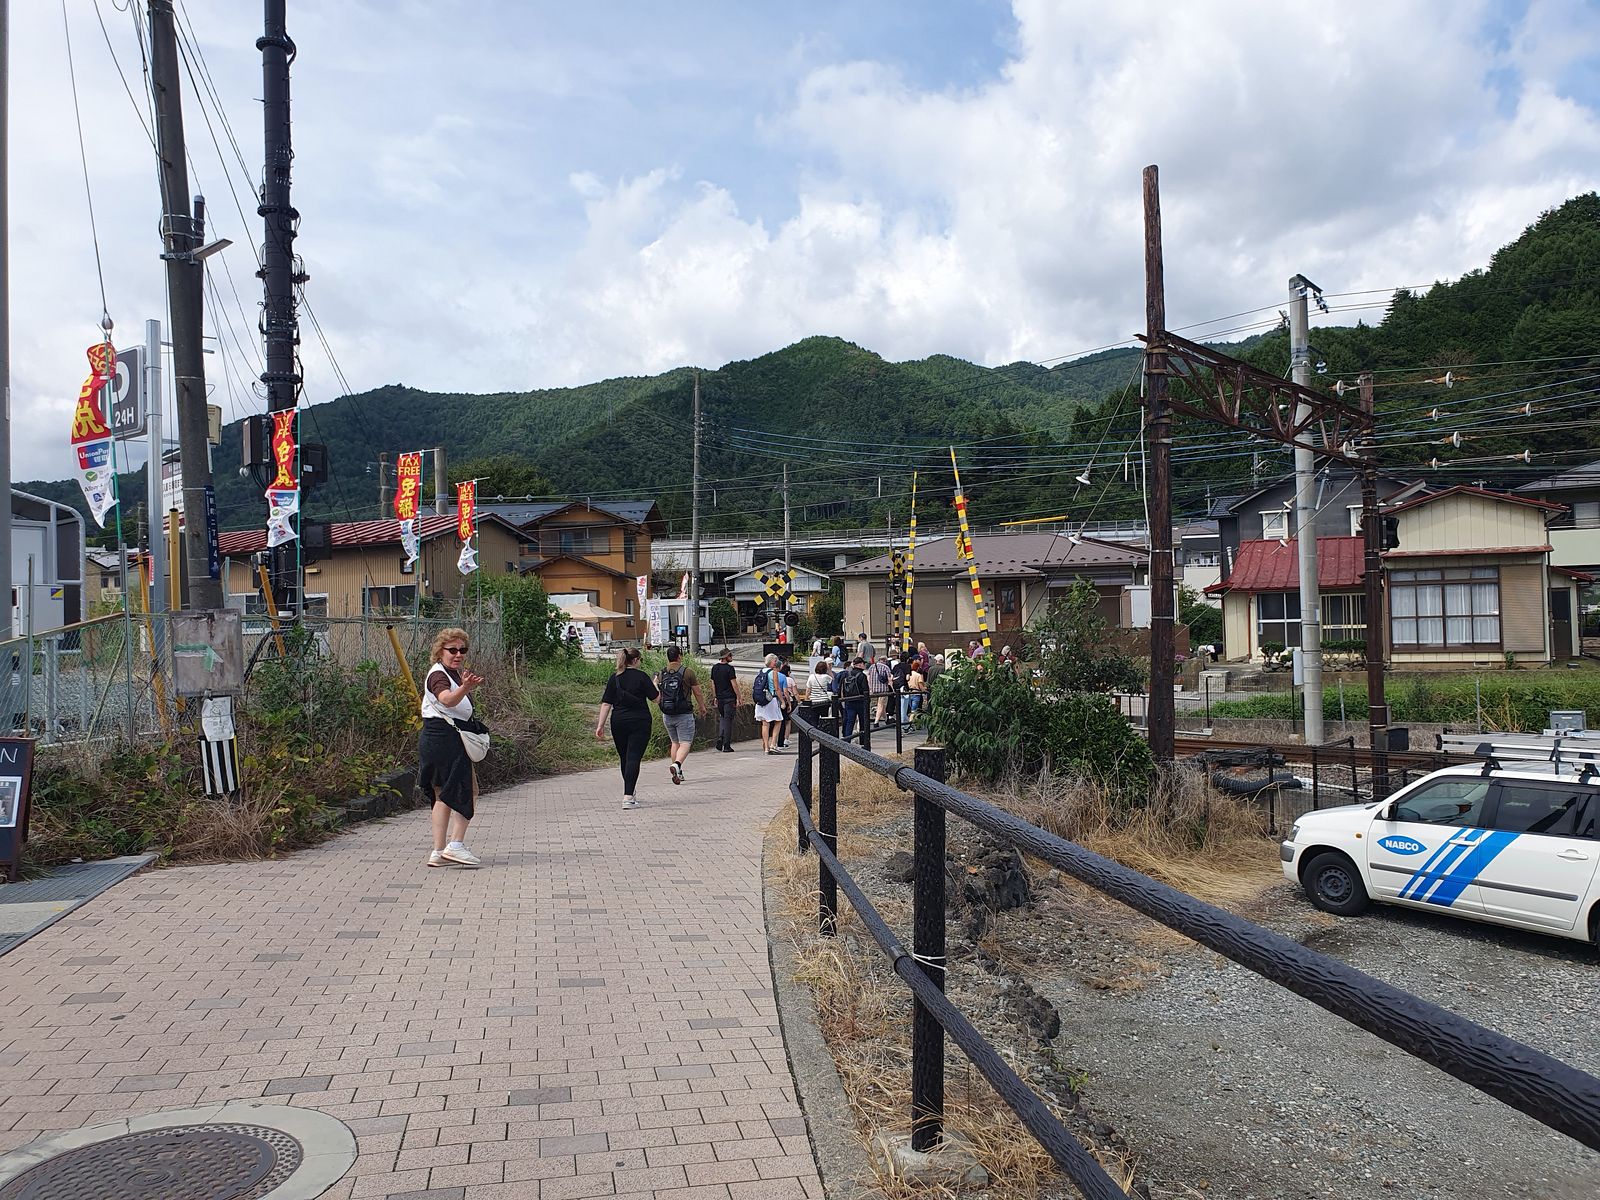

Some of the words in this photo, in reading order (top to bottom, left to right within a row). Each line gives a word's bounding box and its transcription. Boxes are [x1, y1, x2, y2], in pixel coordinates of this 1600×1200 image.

[115, 407, 134, 428] 24H
[400, 457, 419, 467] TAX
[398, 466, 420, 476] FREE
[459, 484, 473, 494] TAX
[398, 478, 416, 519] 免税
[1385, 840, 1419, 851] NABCO
